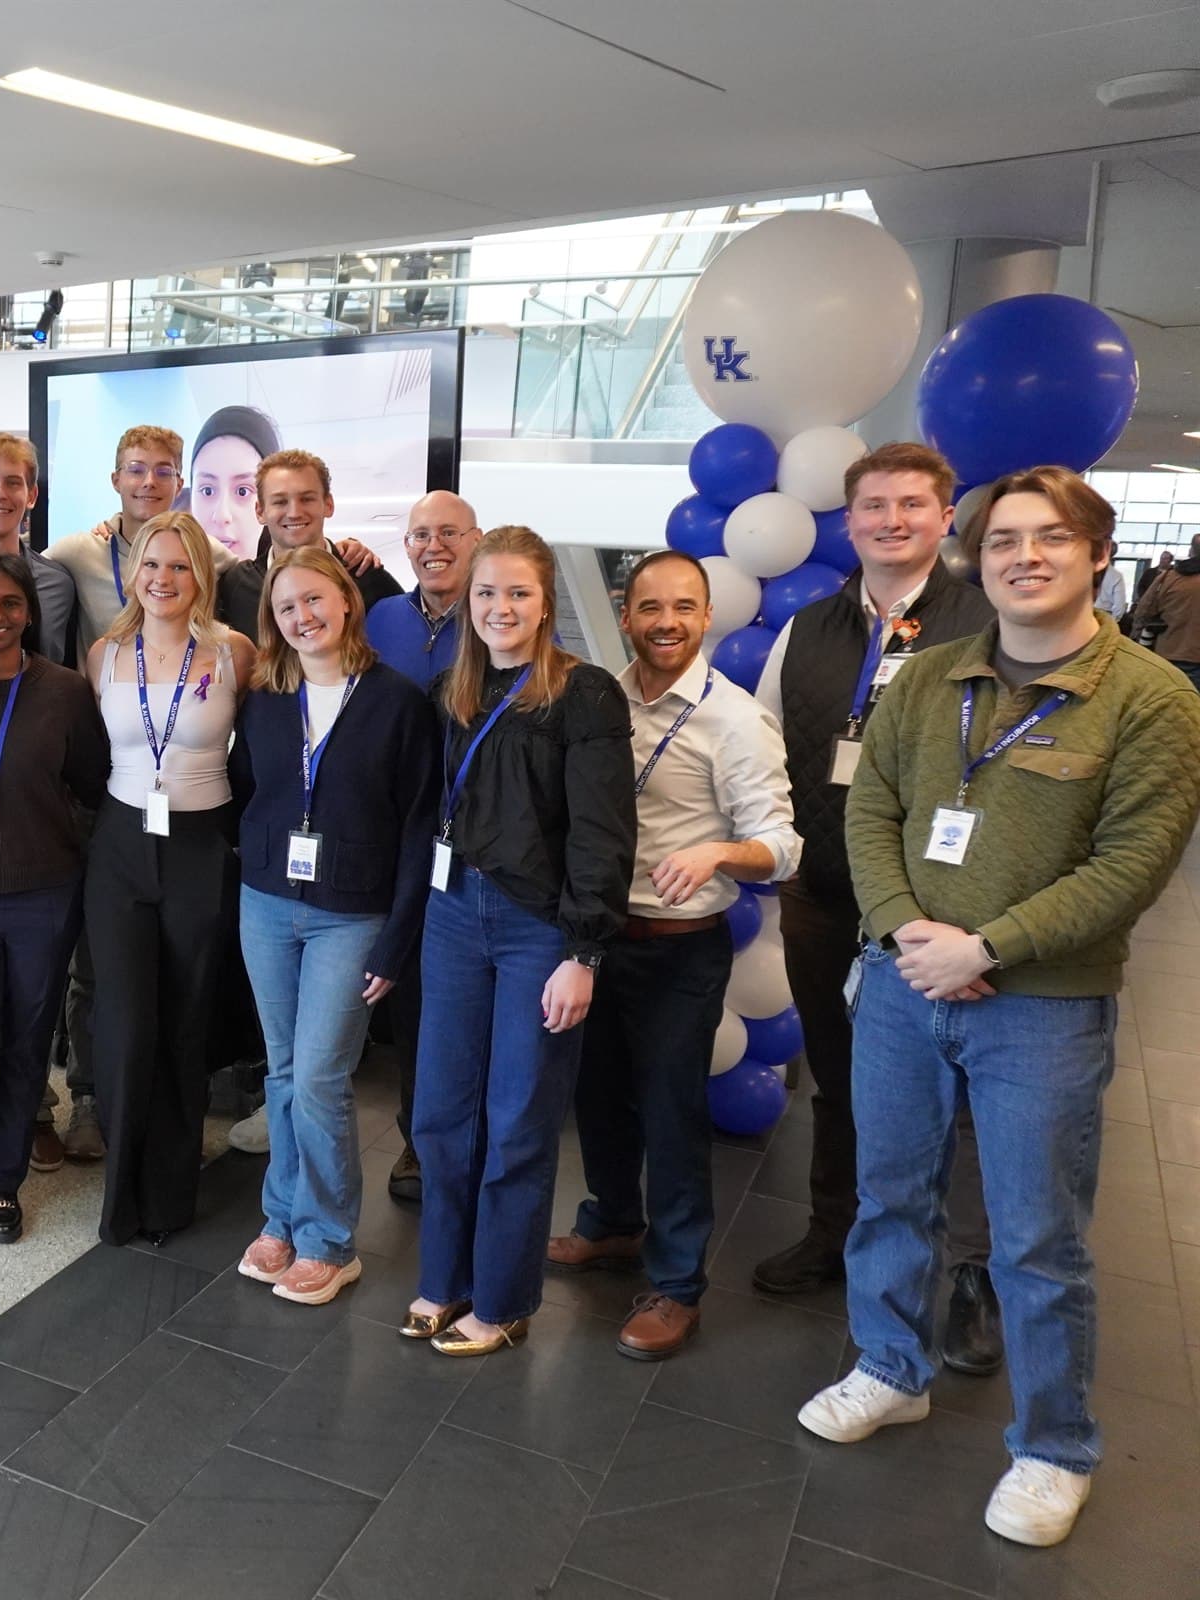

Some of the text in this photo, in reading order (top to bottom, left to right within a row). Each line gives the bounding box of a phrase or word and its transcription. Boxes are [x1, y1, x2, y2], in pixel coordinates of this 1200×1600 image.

[183, 648, 194, 675] INCUBATOR
[145, 717, 156, 748] INCUBATOR
[167, 702, 179, 733] INCUBATOR
[1001, 715, 1041, 747] INCUBATOR
